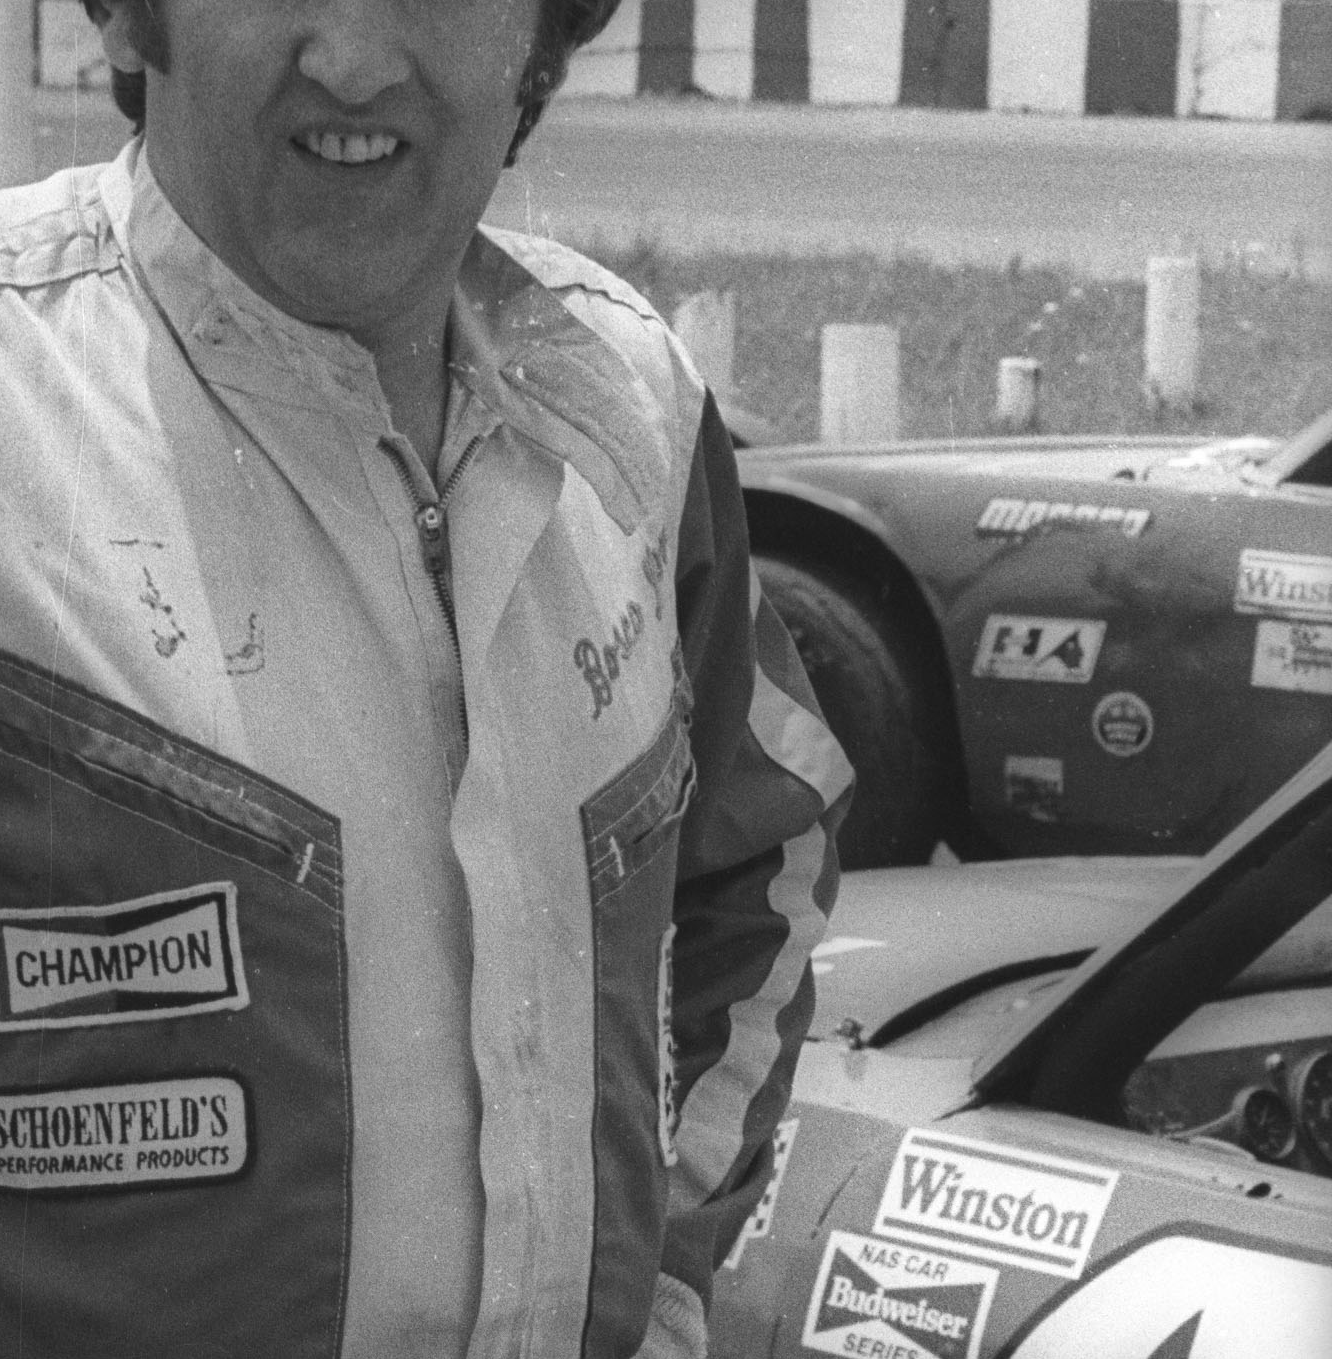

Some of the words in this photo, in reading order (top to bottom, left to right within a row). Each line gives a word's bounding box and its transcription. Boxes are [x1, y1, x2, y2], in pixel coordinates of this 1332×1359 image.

[15, 930, 212, 988] CHAMPION
[136, 1146, 230, 1171] PRODUCTS
[900, 1153, 1089, 1249] Winston
[826, 1274, 968, 1340] Budweiser
